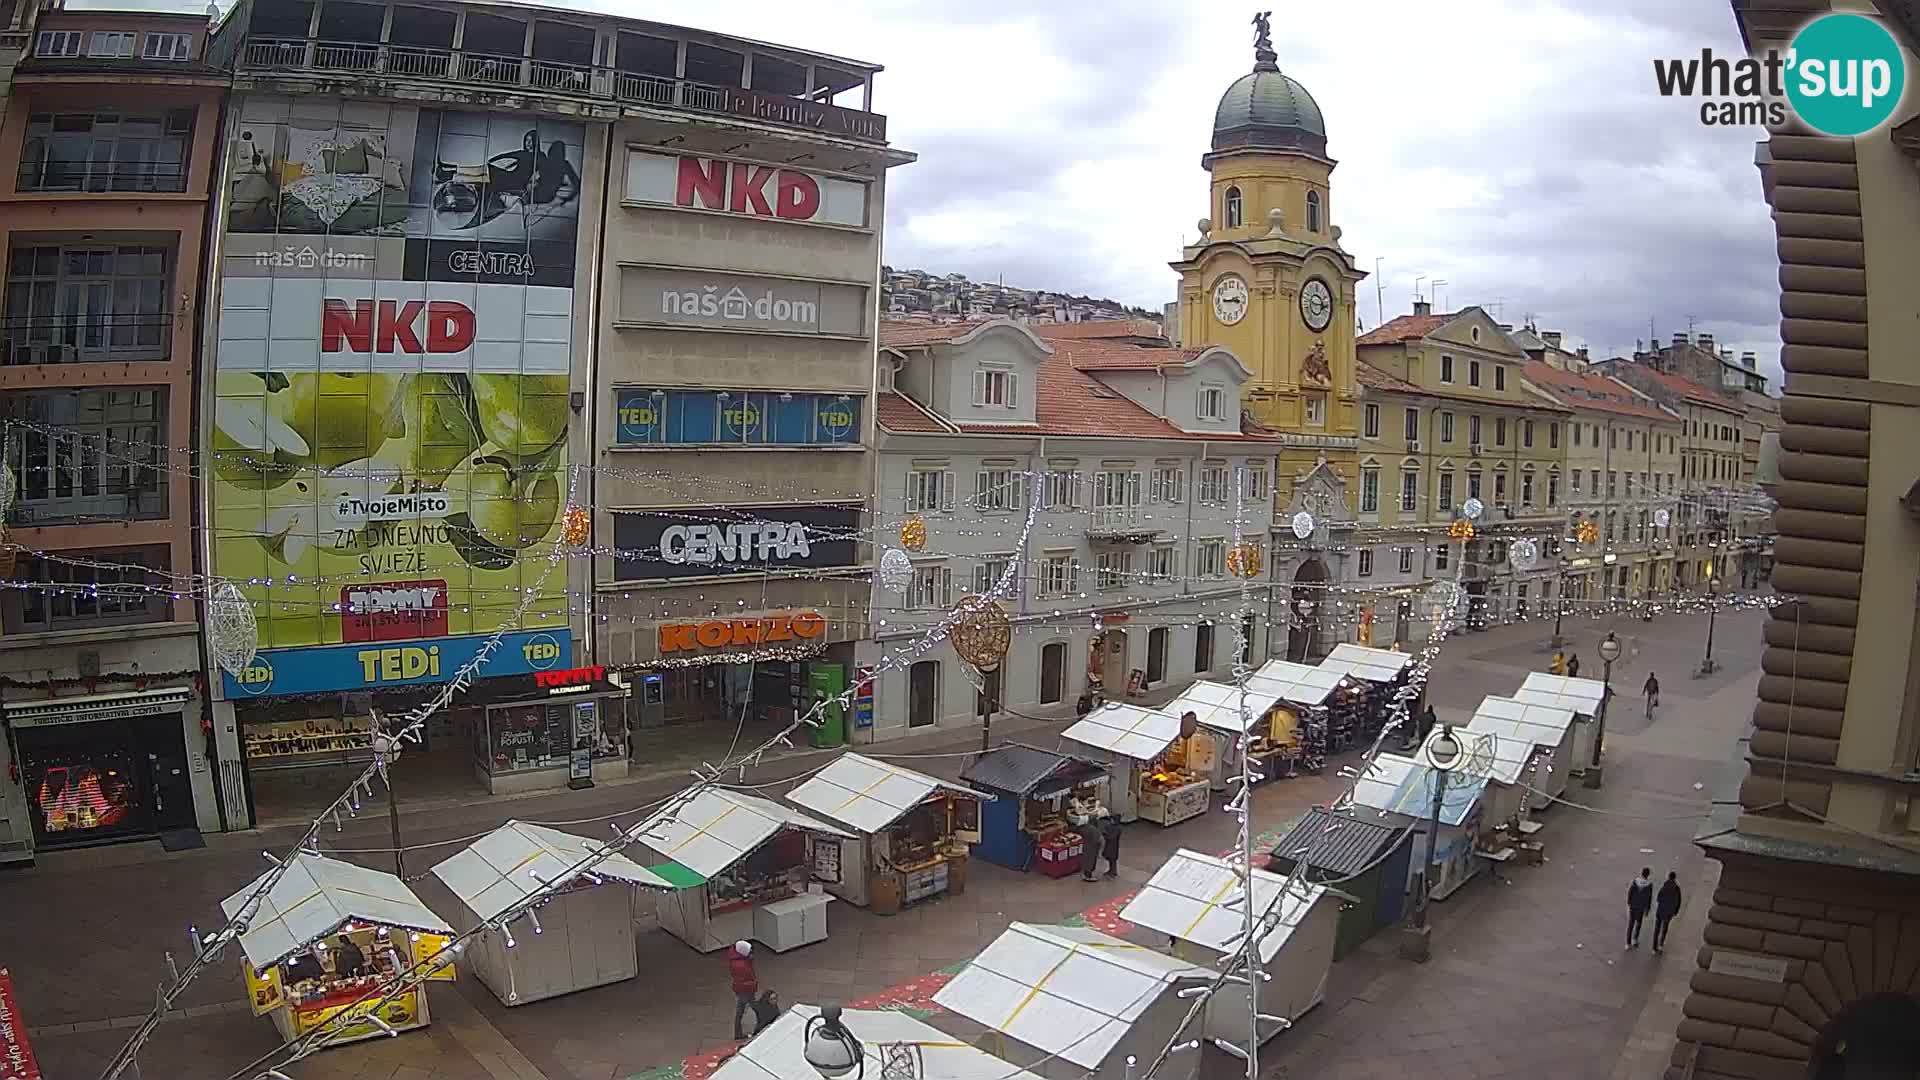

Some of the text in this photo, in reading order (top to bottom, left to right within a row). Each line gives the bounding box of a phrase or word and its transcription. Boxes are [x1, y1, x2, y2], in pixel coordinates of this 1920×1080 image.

[676, 157, 821, 222] NKD
[255, 246, 366, 271] naš dom
[449, 250, 535, 276] CENTRA
[661, 284, 817, 324] naš dom
[321, 298, 477, 355] NKD
[619, 407, 658, 426] TEDi
[724, 410, 760, 426] TEDi
[819, 411, 853, 428] TEDi
[338, 497, 447, 517] #TvojeMisto
[334, 524, 451, 550] ZA DNEVNO
[659, 521, 812, 565] CENTRA
[359, 547, 428, 575] SVJEŽE
[349, 587, 439, 615] TOMMY
[659, 613, 826, 654] KORZO
[358, 645, 441, 683] TEDi
[523, 643, 560, 660] TEDi
[533, 664, 606, 688] TOMMY
